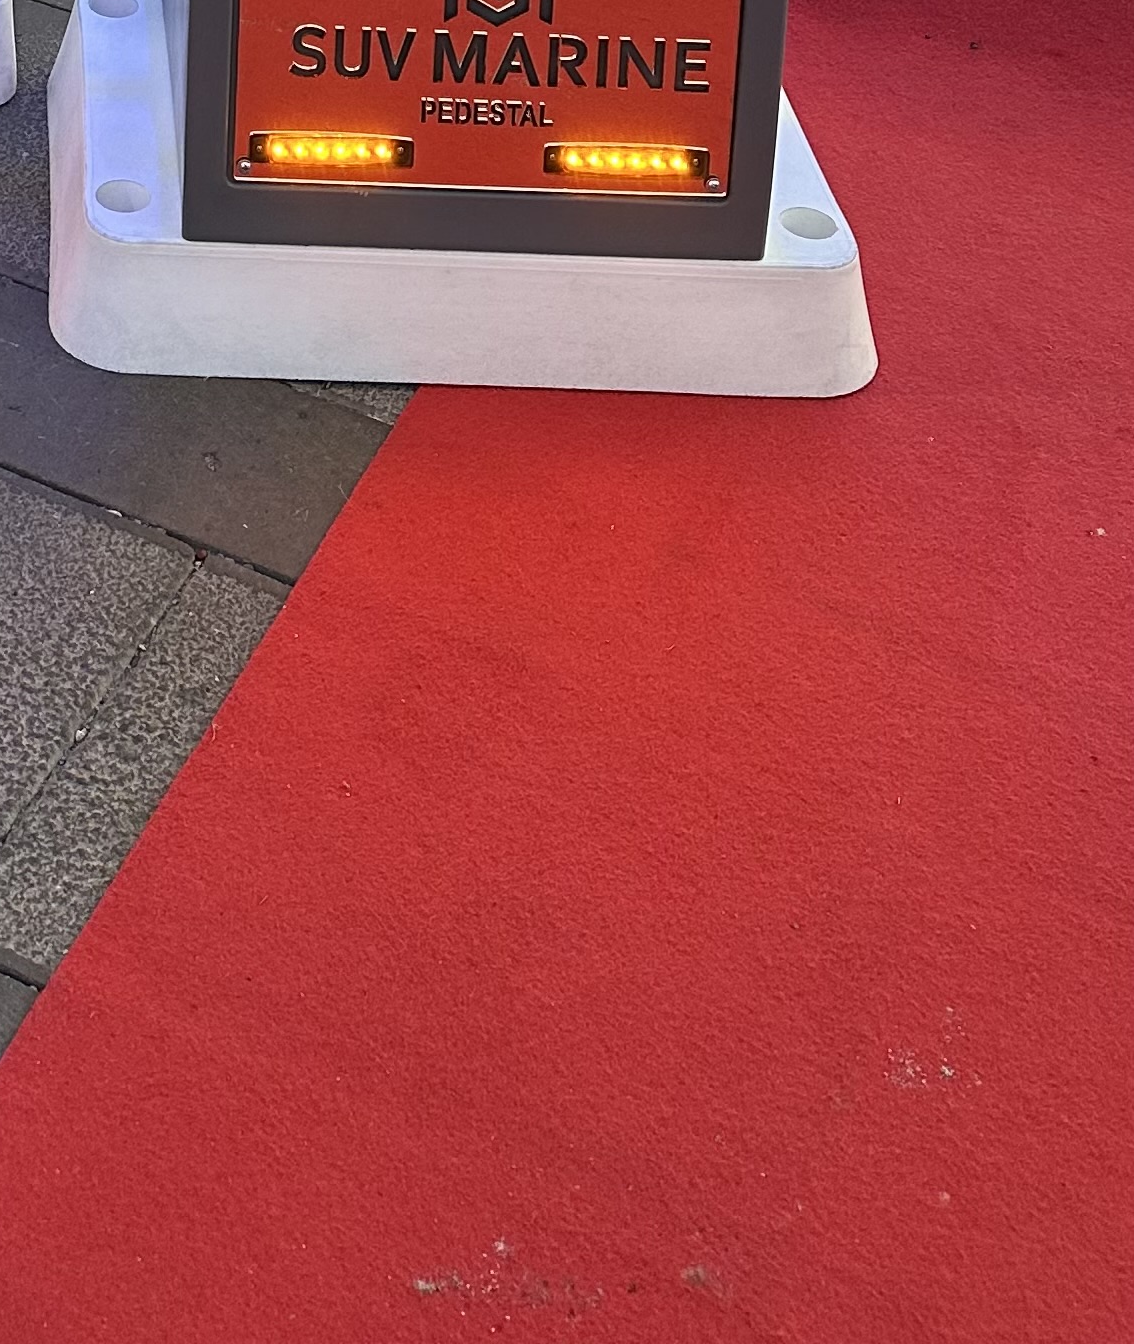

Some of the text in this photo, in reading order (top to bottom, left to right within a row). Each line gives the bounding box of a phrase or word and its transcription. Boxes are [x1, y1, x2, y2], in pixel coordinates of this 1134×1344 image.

[288, 22, 712, 94] SUV MARINE
[419, 96, 555, 128] PEDESTAL
